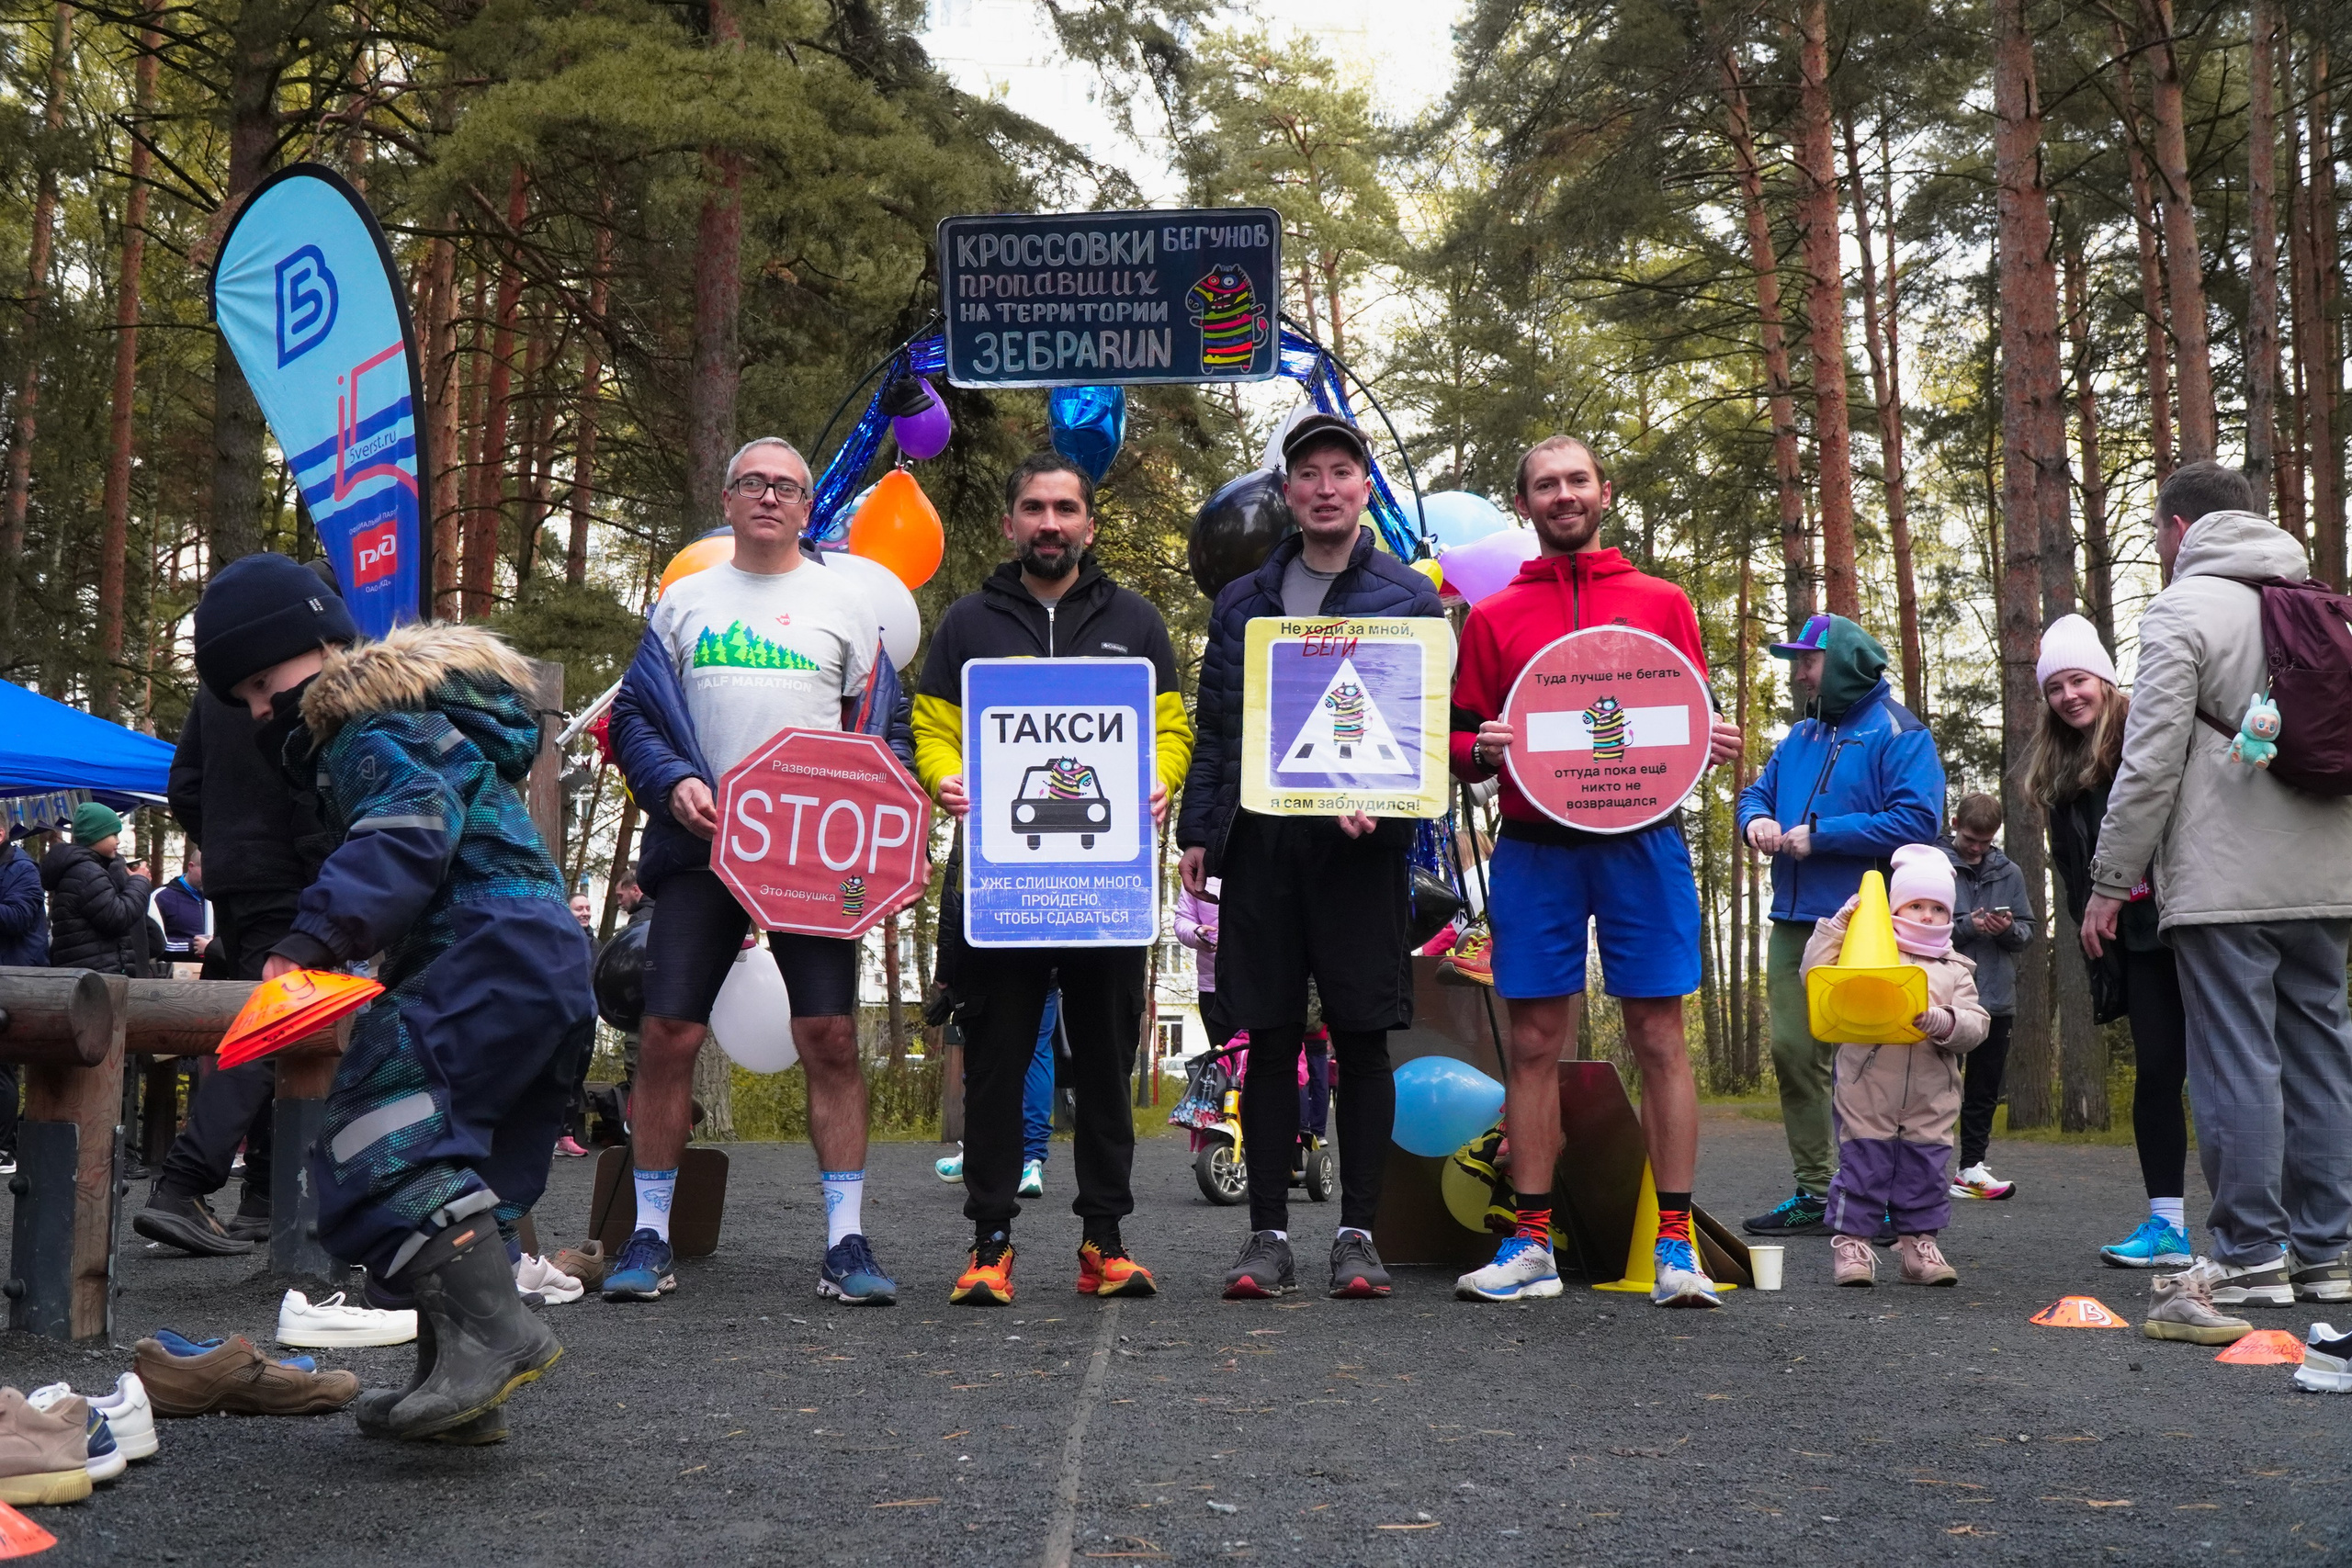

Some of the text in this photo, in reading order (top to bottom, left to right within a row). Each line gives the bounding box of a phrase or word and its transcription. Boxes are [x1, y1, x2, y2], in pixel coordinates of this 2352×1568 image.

[956, 224, 1270, 268] КРОССОВКИ БЕГУНОВ
[959, 301, 1169, 322] НА ТЕРРИТОРИИ
[349, 431, 397, 464] 5verst.ru
[1281, 622, 1301, 635] Не
[1347, 625, 1365, 635] за
[1368, 623, 1415, 637] мной,
[1302, 636, 1359, 658] БЕГИ
[696, 676, 812, 694] HALF MARATHON
[1534, 668, 1681, 687] Туда лучше не бегать
[990, 712, 1124, 744] ТАКСИ
[772, 760, 888, 784] Разворачивайся!!!
[1555, 762, 1668, 779] оттуда пока ещё
[1581, 781, 1642, 793] никто не
[1283, 798, 1314, 808] сам
[1317, 795, 1420, 812] заблудился!
[1566, 796, 1657, 810] возвращался
[731, 789, 911, 874] STOP
[979, 875, 1142, 890] УЖЕ СЛИШКОМ МНОГО
[759, 884, 837, 903] Это ловушка
[994, 911, 1129, 926] ЧТОБЫ СДАВАТЬСЯ
